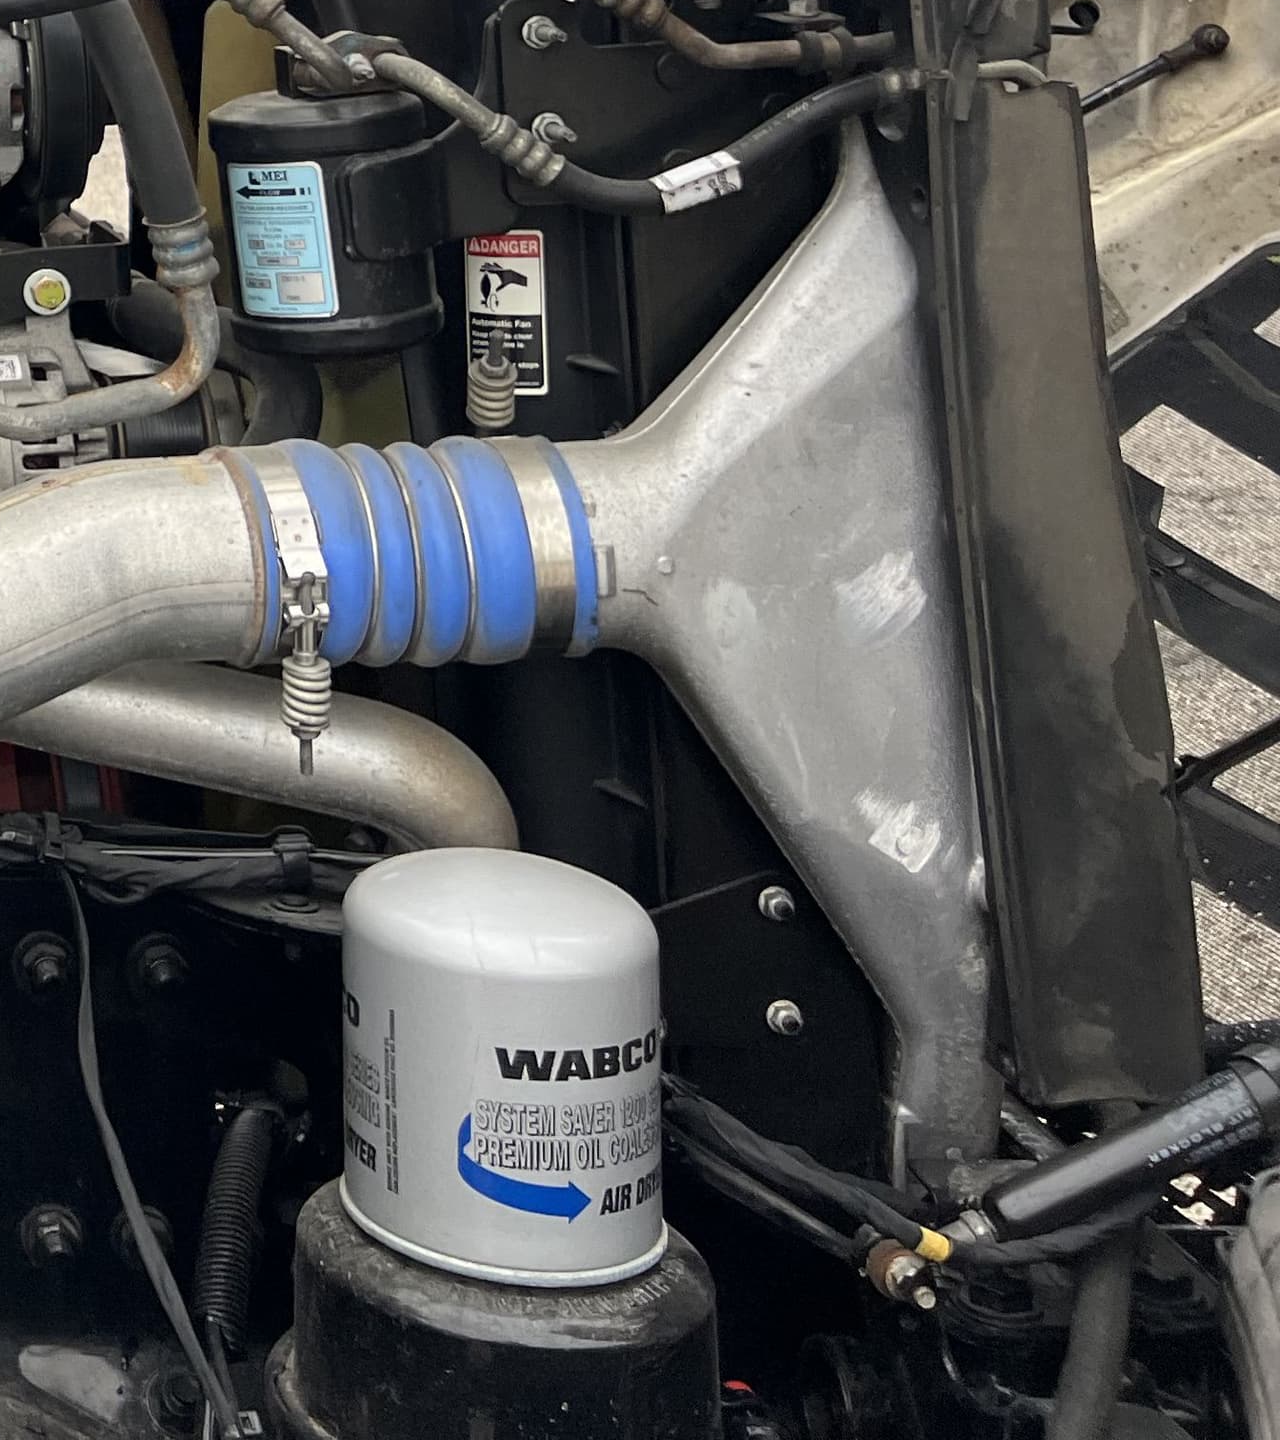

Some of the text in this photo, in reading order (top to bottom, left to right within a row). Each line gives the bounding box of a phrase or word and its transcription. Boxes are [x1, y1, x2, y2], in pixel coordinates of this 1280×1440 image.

[261, 170, 288, 181] MEI
[480, 239, 539, 254] DANGER
[471, 318, 532, 329] Automatic Fan
[494, 1028, 657, 1082] WABCO
[475, 1099, 556, 1136] SYSTEM
[560, 1101, 615, 1136] SAVER
[474, 1131, 571, 1171] PREMIUM
[575, 1138, 605, 1170] OIL
[600, 1182, 632, 1216] AIR
